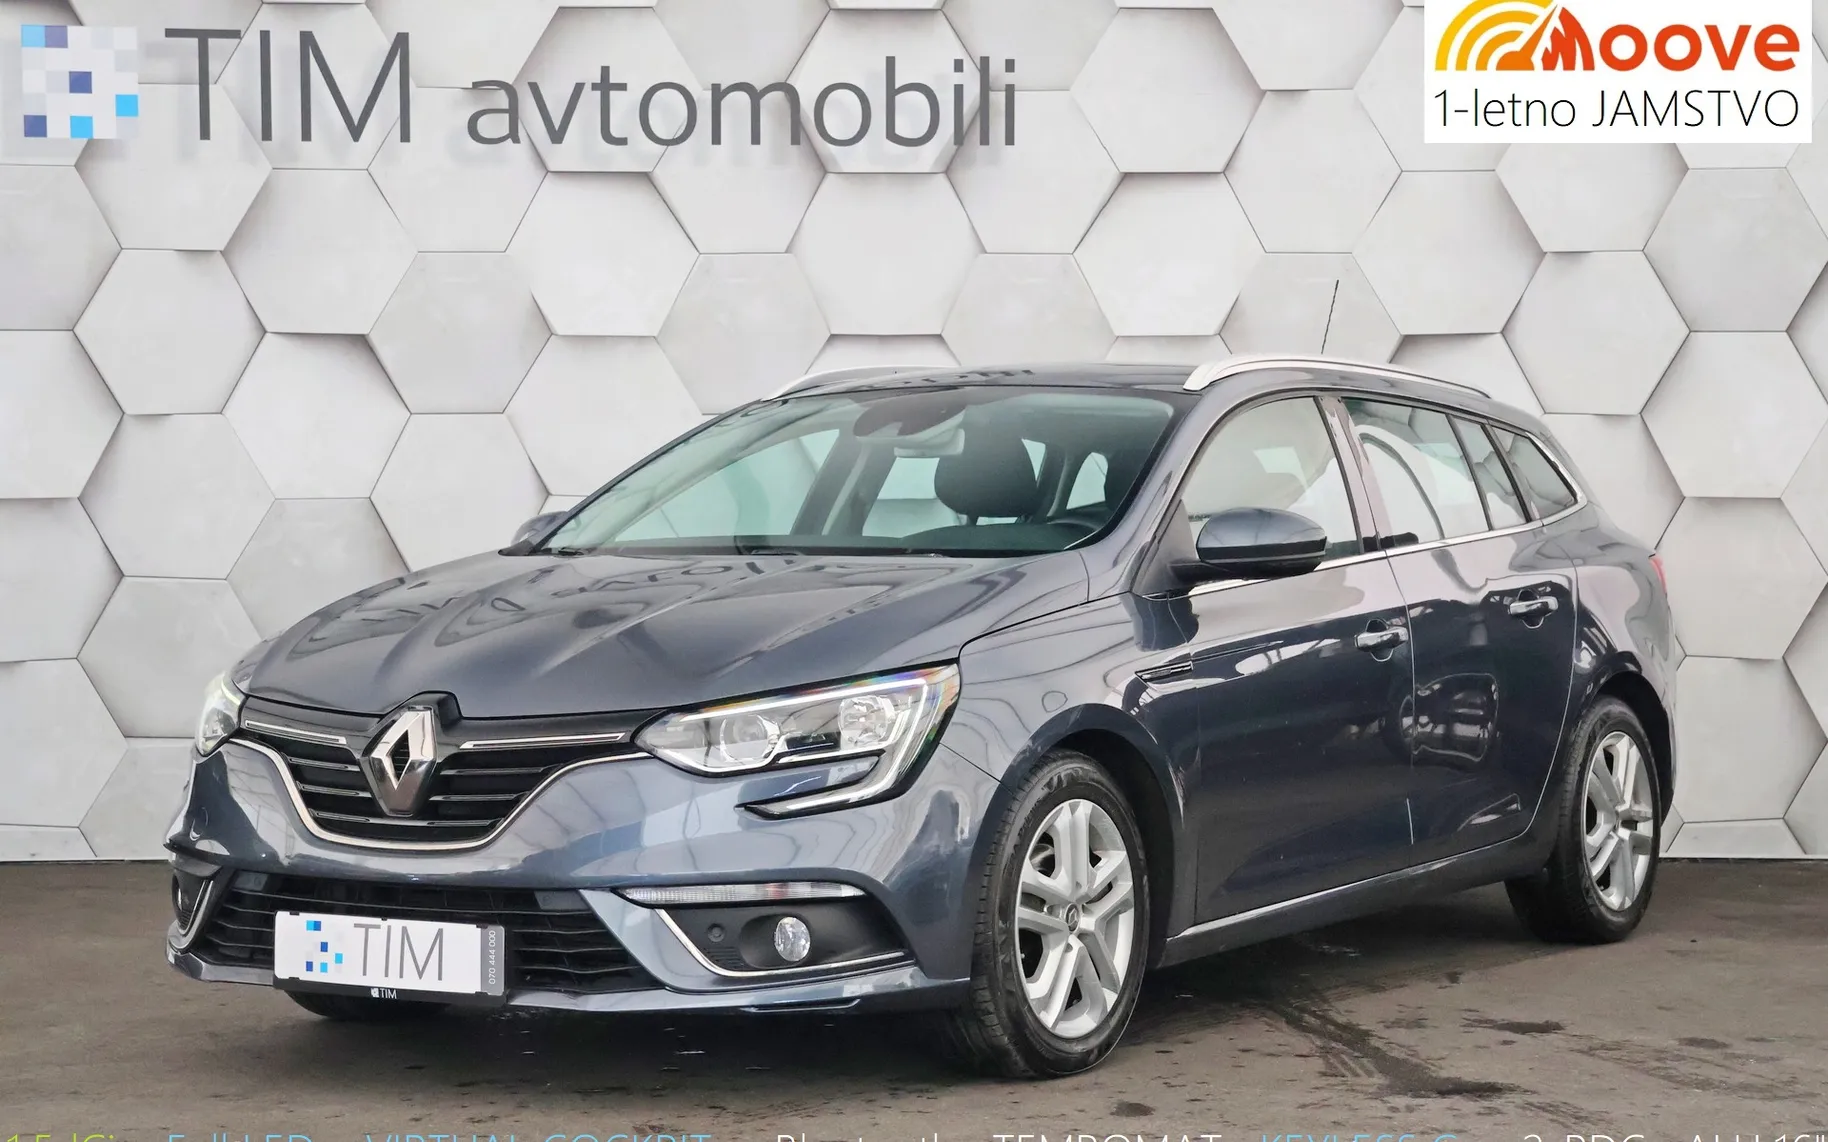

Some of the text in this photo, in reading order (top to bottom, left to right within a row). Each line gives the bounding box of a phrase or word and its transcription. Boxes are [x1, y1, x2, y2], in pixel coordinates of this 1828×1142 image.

[165, 29, 1016, 147] TIM avtomobili
[353, 922, 444, 982] TIM
[488, 930, 496, 985] 070 444 000
[379, 987, 397, 999] TIM
